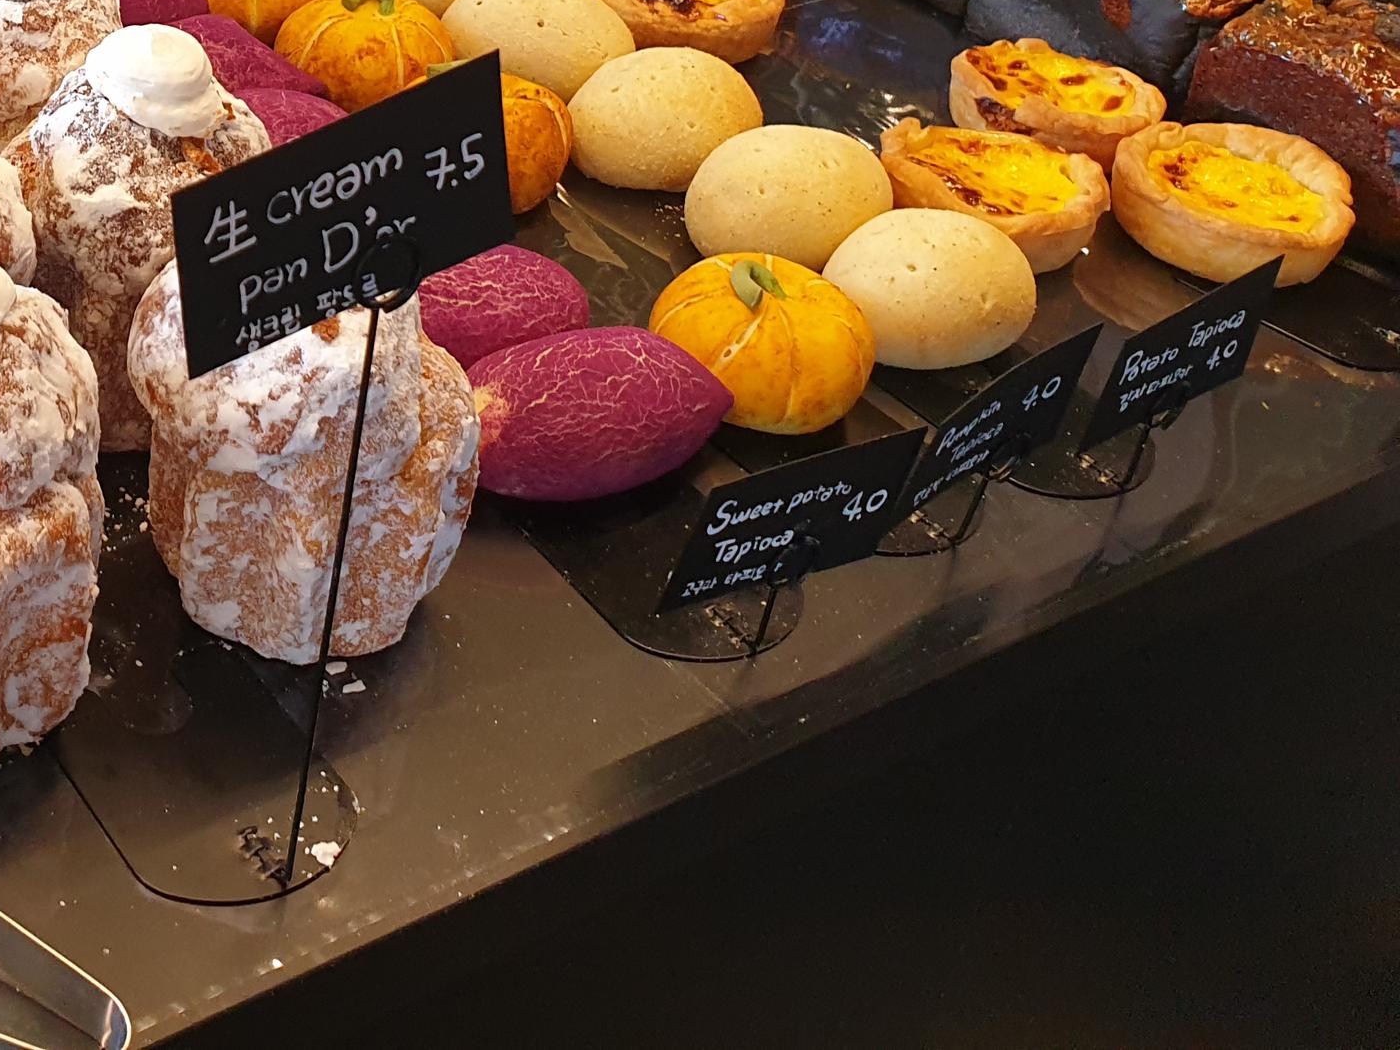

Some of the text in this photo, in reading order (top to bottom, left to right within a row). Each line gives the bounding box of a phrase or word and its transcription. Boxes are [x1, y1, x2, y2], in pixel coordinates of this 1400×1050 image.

[424, 132, 486, 191] 7.5
[203, 147, 403, 264] 生 cream
[235, 303, 302, 353] 생크림
[1118, 309, 1246, 386] Potato Tapioca
[1206, 339, 1238, 371] 4.0
[1021, 375, 1062, 411] 4.0
[706, 480, 852, 536] Sweet potato
[841, 488, 888, 522] 4.0
[714, 529, 795, 564] Tapioca
